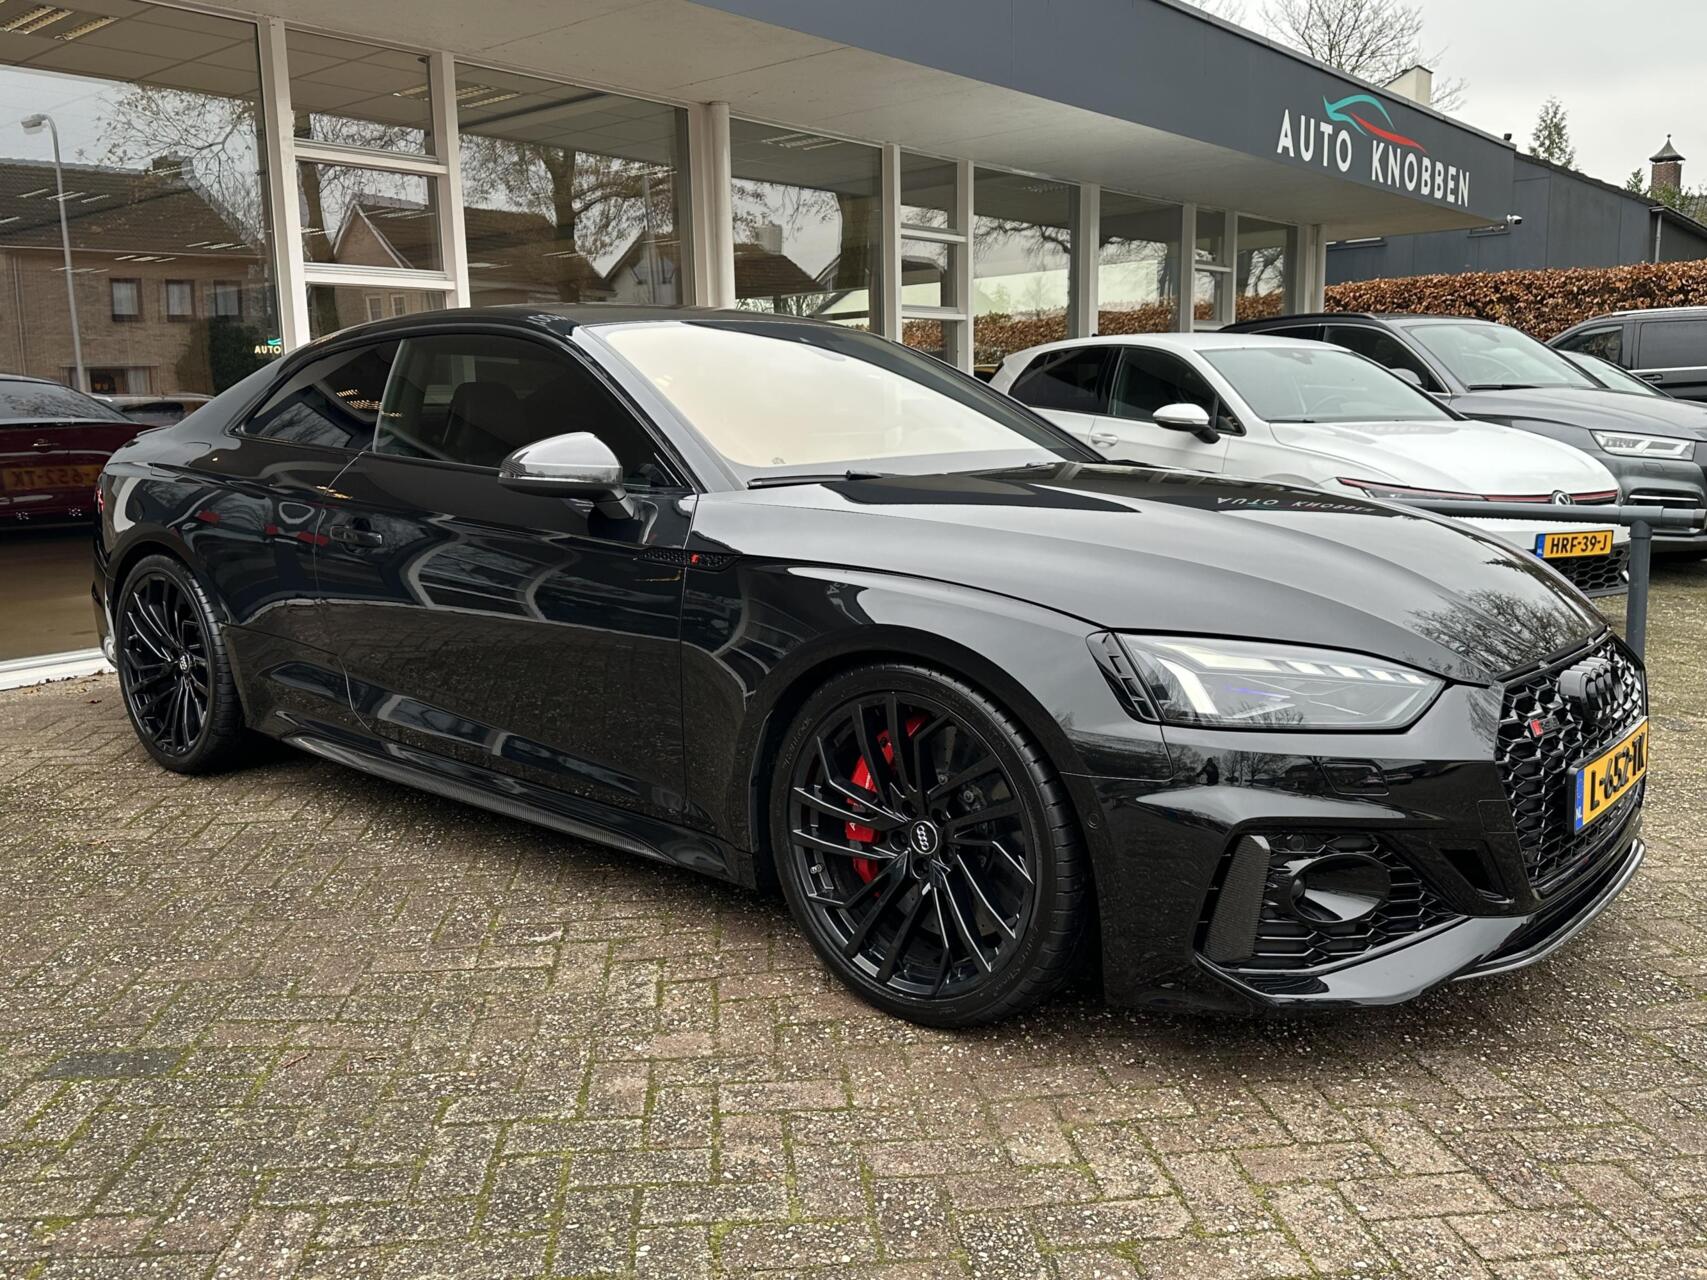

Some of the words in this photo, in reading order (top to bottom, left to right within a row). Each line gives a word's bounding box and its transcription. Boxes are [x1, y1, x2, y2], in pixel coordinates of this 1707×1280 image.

[1277, 109, 1352, 172] AUTO
[1372, 140, 1470, 207] KNOBBEN
[254, 345, 281, 354] AUTO
[1550, 534, 1608, 554] HRF-39-J
[1590, 732, 1646, 811] L-652-TK
